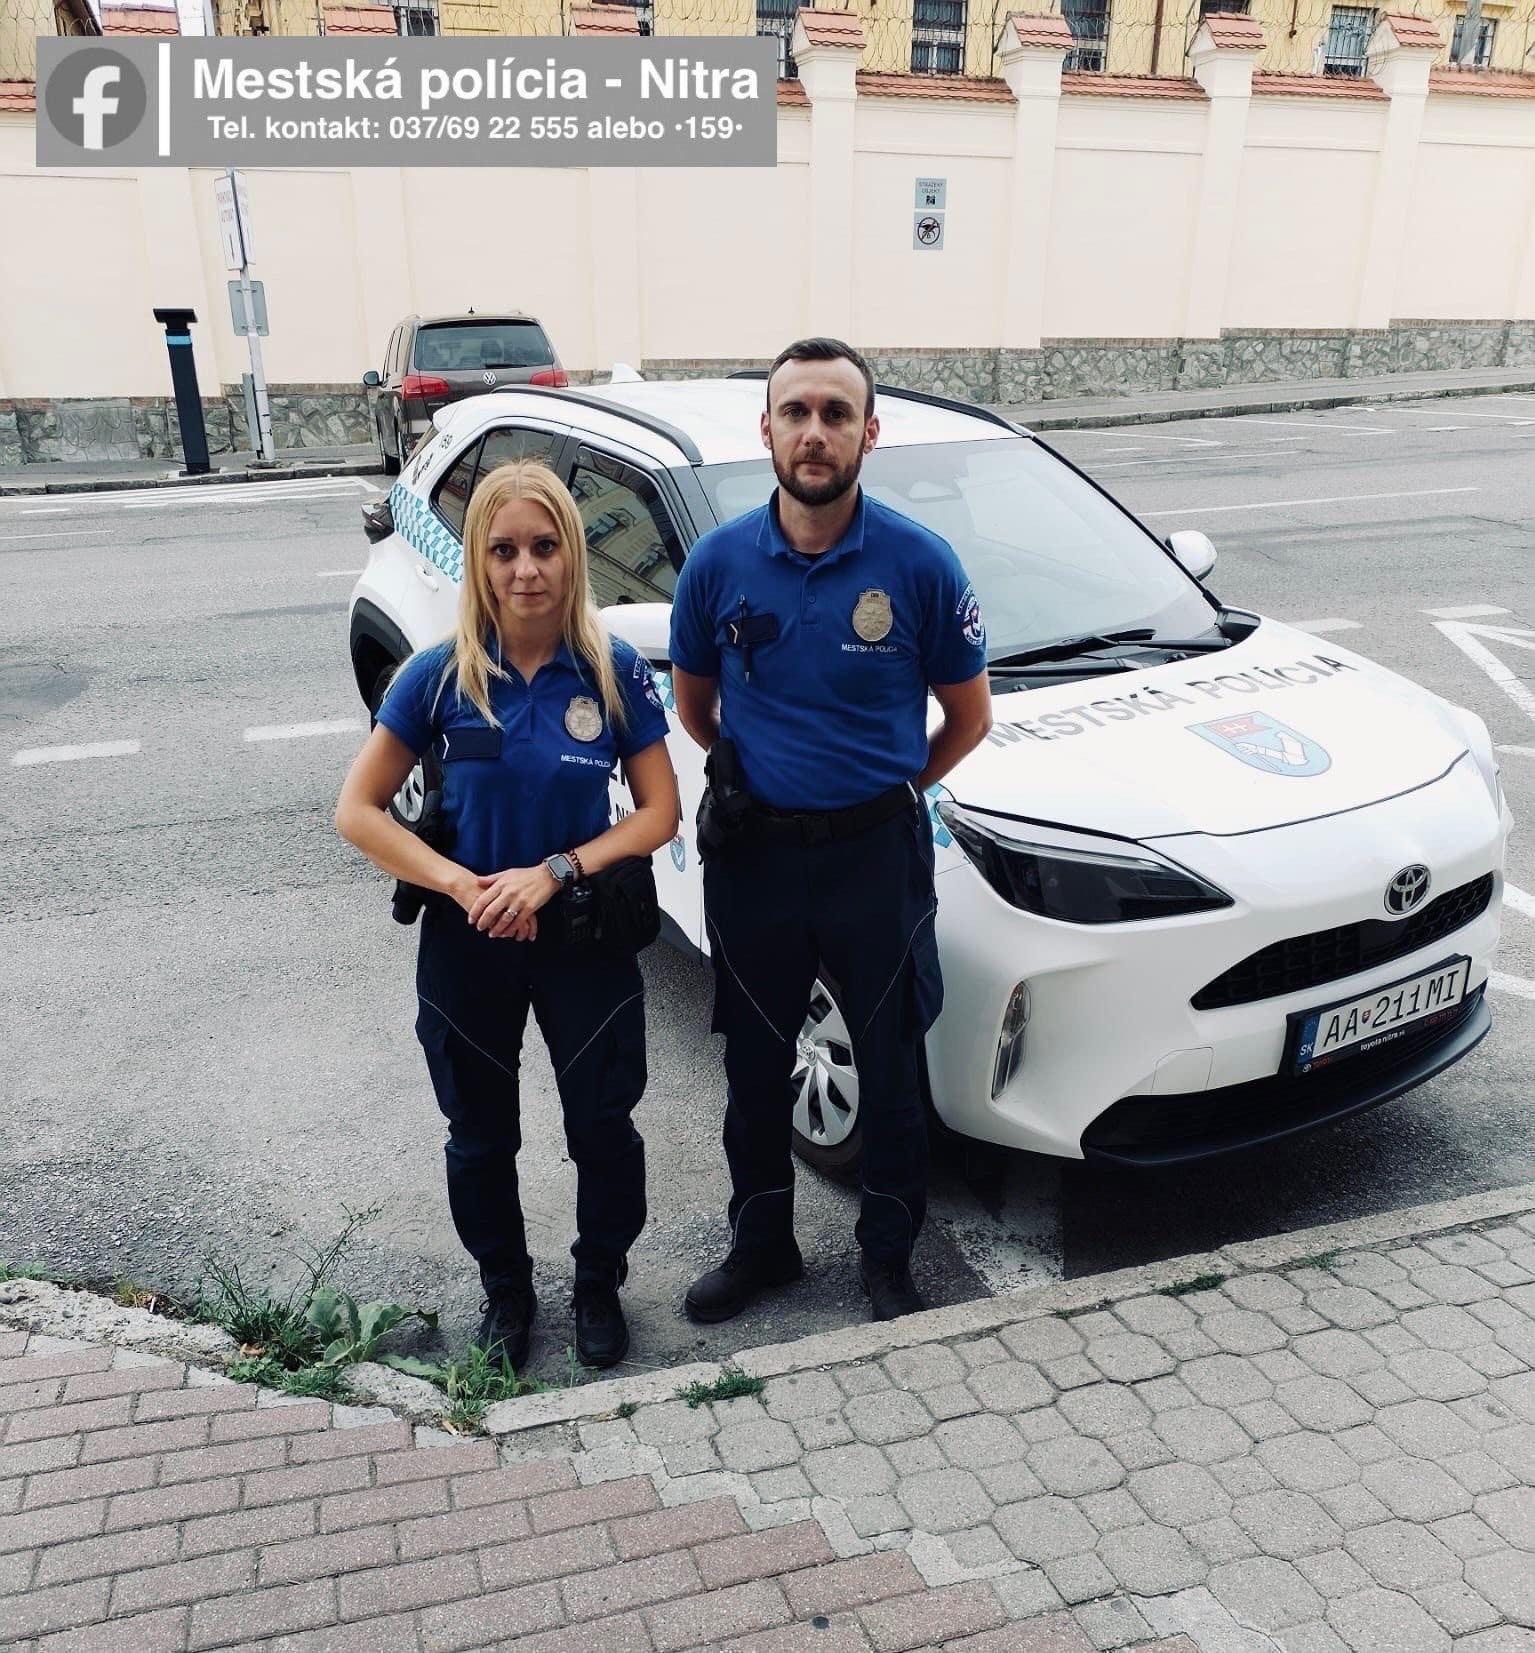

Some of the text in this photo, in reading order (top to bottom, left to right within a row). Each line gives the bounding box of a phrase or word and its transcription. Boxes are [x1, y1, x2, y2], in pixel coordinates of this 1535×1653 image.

[986, 654, 1360, 748] MESTSKÁ POLÍCIA
[1299, 1042, 1314, 1056] SK
